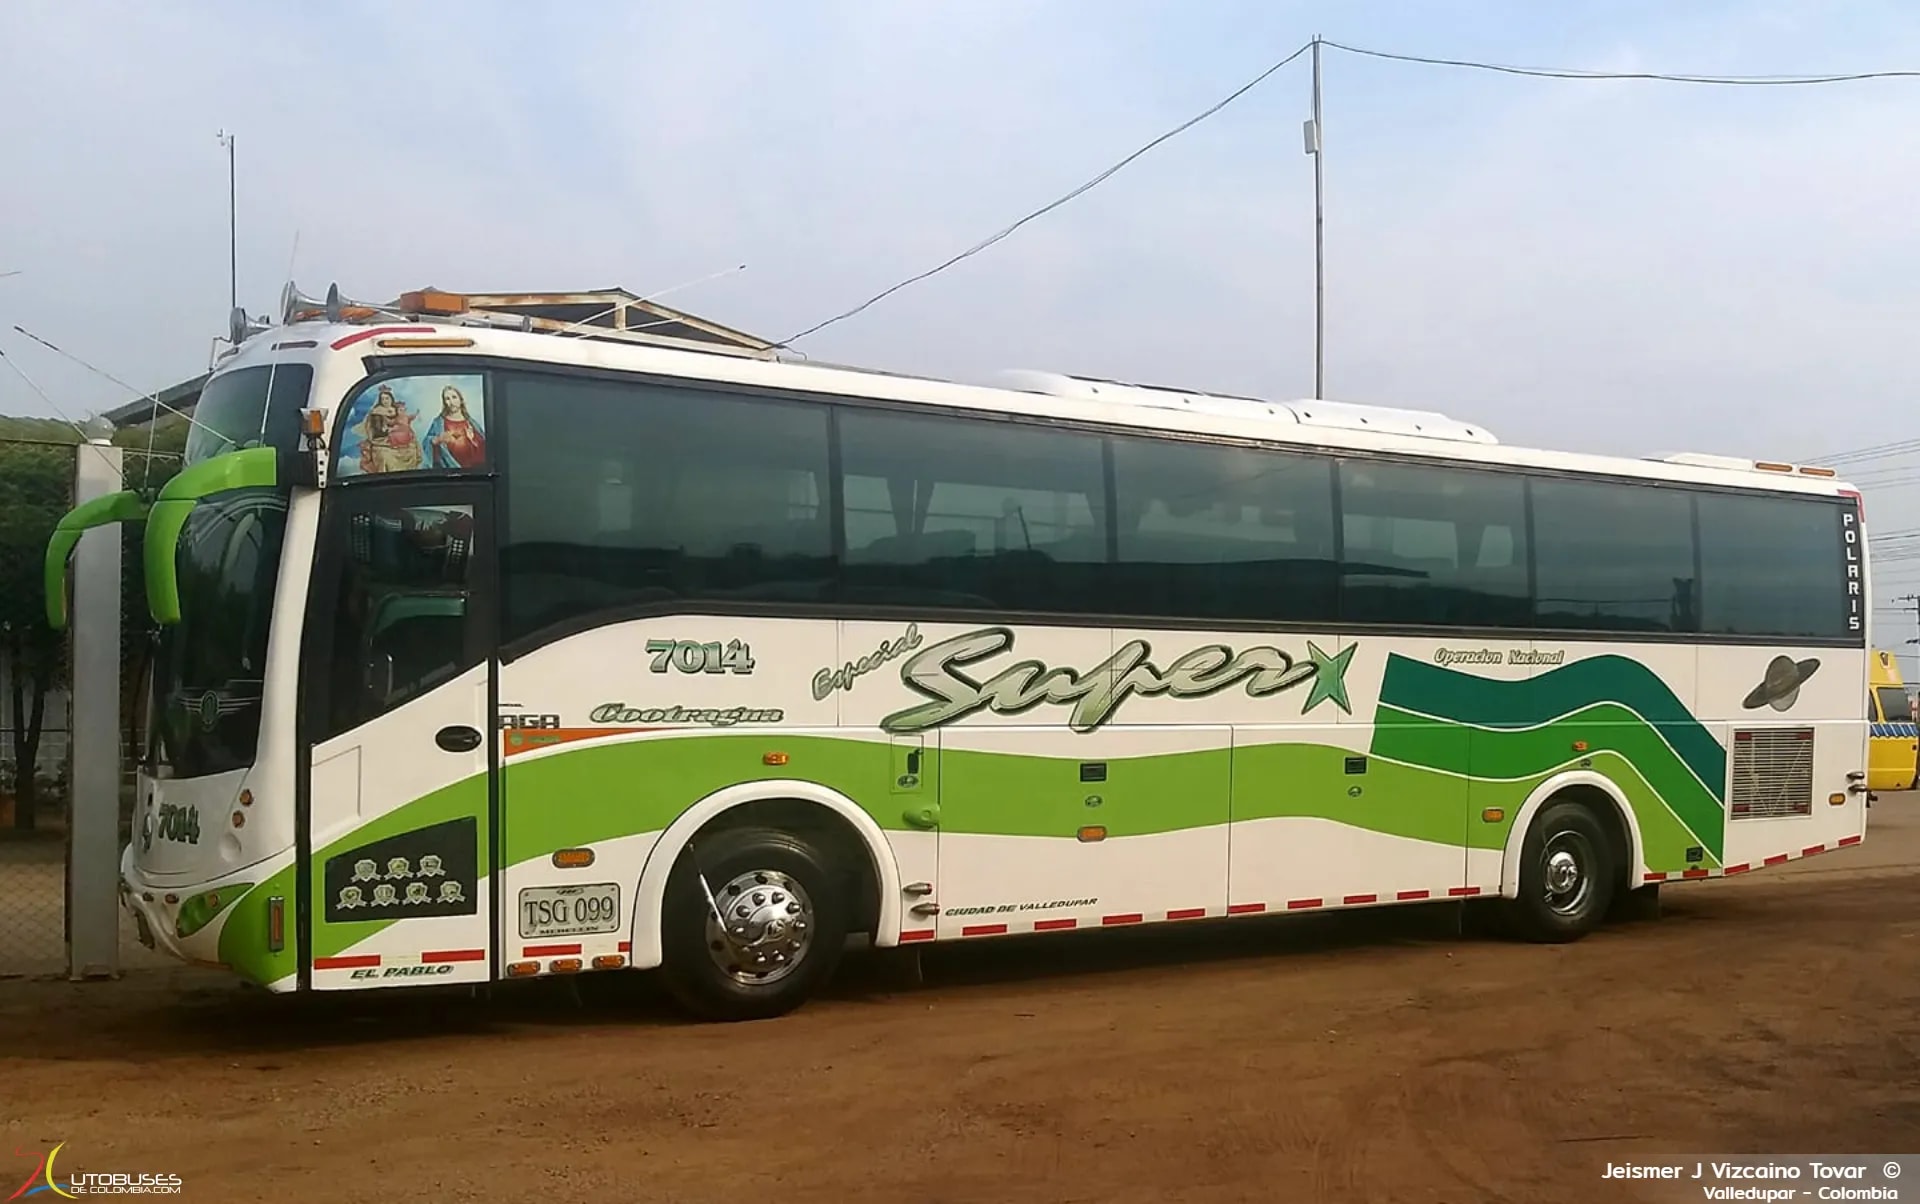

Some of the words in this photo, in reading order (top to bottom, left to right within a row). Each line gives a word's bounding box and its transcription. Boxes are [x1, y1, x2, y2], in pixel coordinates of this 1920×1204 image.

[1843, 513, 1860, 630] POLARIS
[644, 638, 756, 675] 7014
[812, 622, 924, 701] Especial
[1434, 647, 1503, 666] Operacion
[1508, 649, 1564, 665] Nacional
[879, 626, 1319, 733] Super
[158, 803, 200, 845] 7014
[524, 899, 569, 926] TSG
[574, 895, 615, 923] 099
[945, 905, 996, 917] CIUDAD
[996, 904, 1017, 913] DE
[1019, 897, 1099, 912] VALLEDUPAR
[350, 968, 380, 981] EL
[383, 965, 455, 979] PABLO
